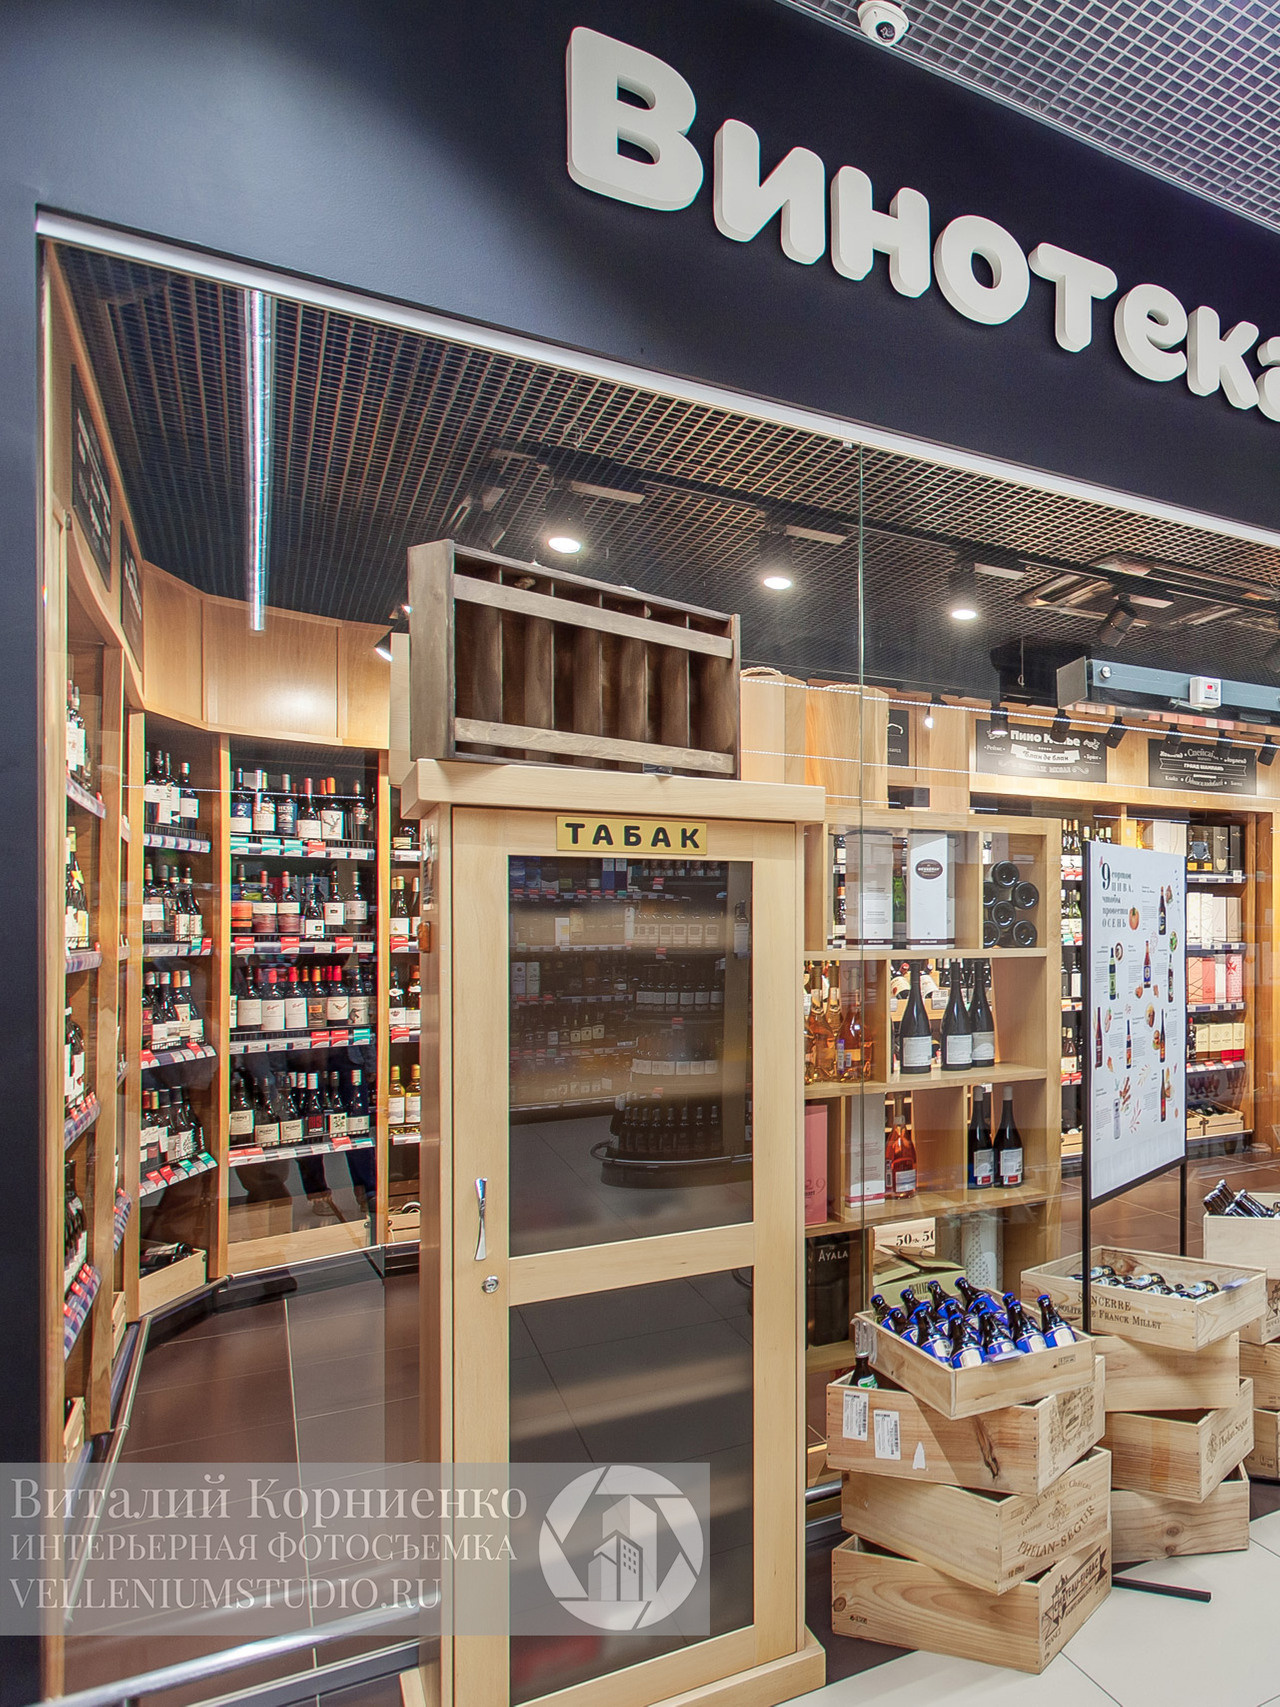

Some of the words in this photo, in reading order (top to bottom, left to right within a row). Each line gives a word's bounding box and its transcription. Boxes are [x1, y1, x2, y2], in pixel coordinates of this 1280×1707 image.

[1010, 730, 1042, 743] Пино
[565, 823, 700, 849] ТАБАК
[1101, 862, 1111, 890] 9
[1102, 917, 1127, 928] ОСЕНЬ
[895, 1233, 913, 1247] 50
[818, 1248, 849, 1262] AYALA
[1077, 1291, 1132, 1312] SNCERRE
[1098, 1309, 1130, 1325] FRANCK
[1132, 1315, 1162, 1330] MILLET
